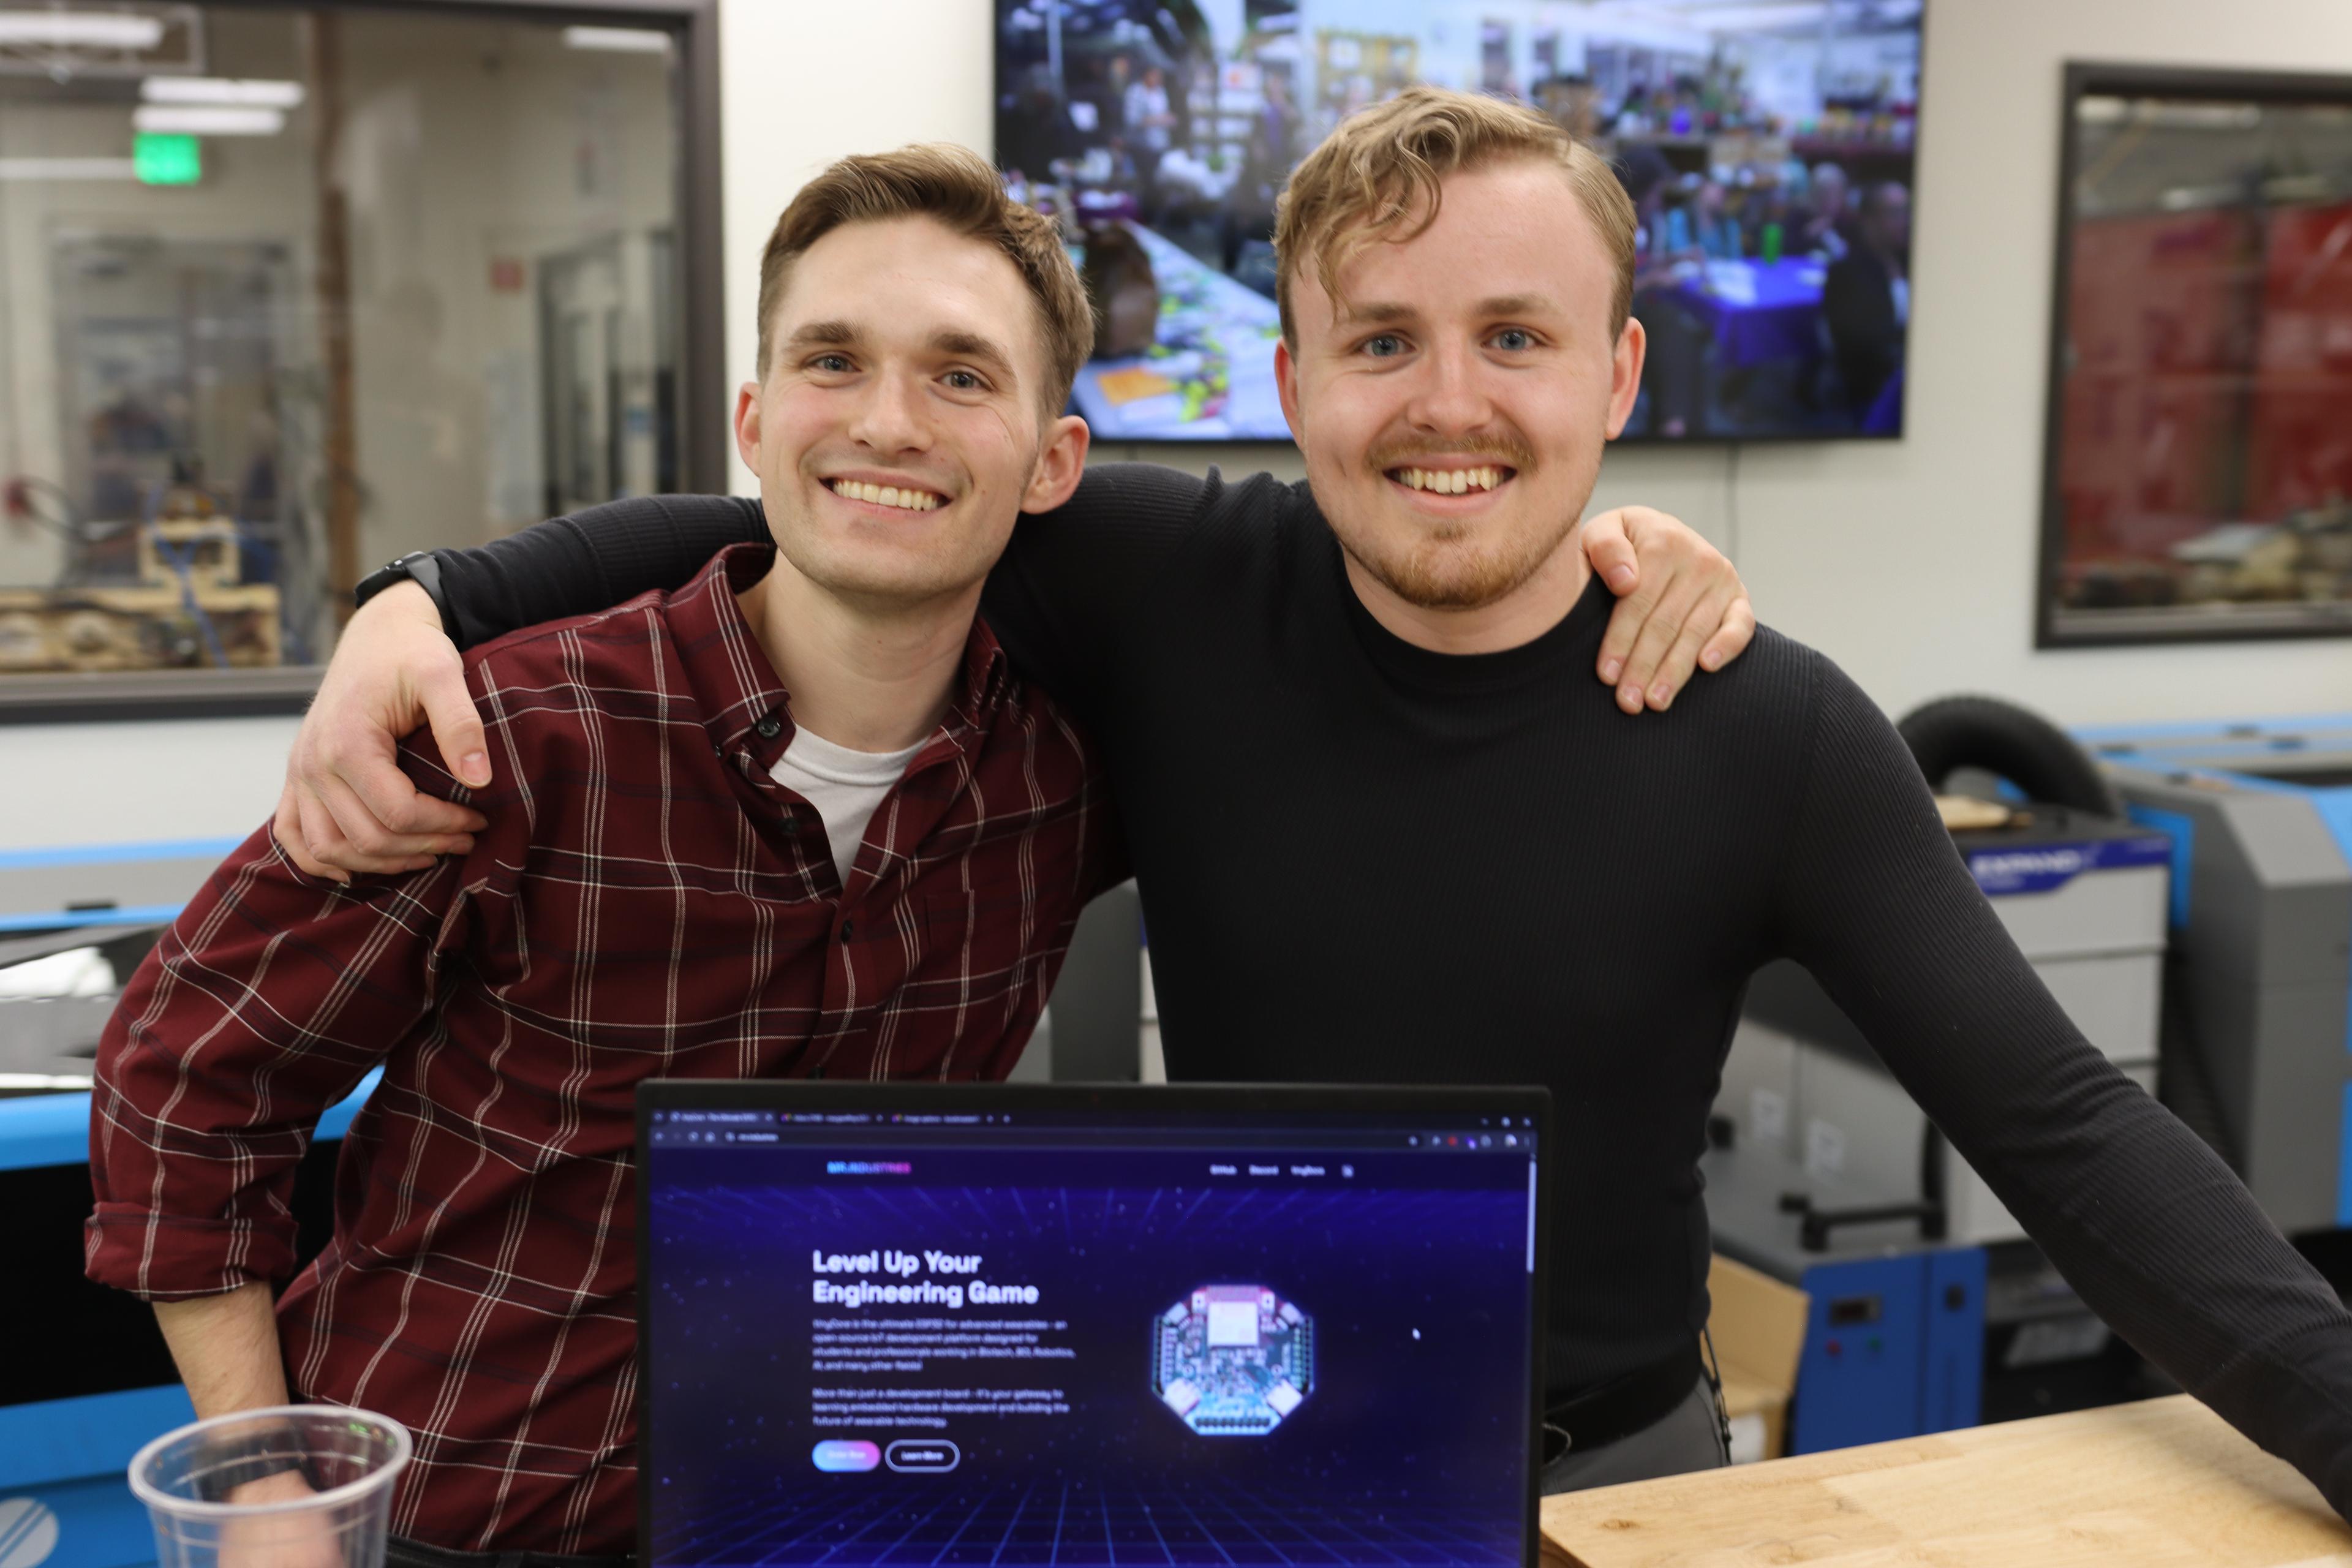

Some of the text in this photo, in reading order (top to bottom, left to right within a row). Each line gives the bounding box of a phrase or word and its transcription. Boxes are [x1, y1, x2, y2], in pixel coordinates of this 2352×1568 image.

[813, 1249, 982, 1278] Level Up Your
[813, 1280, 1039, 1308] Engineering Game
